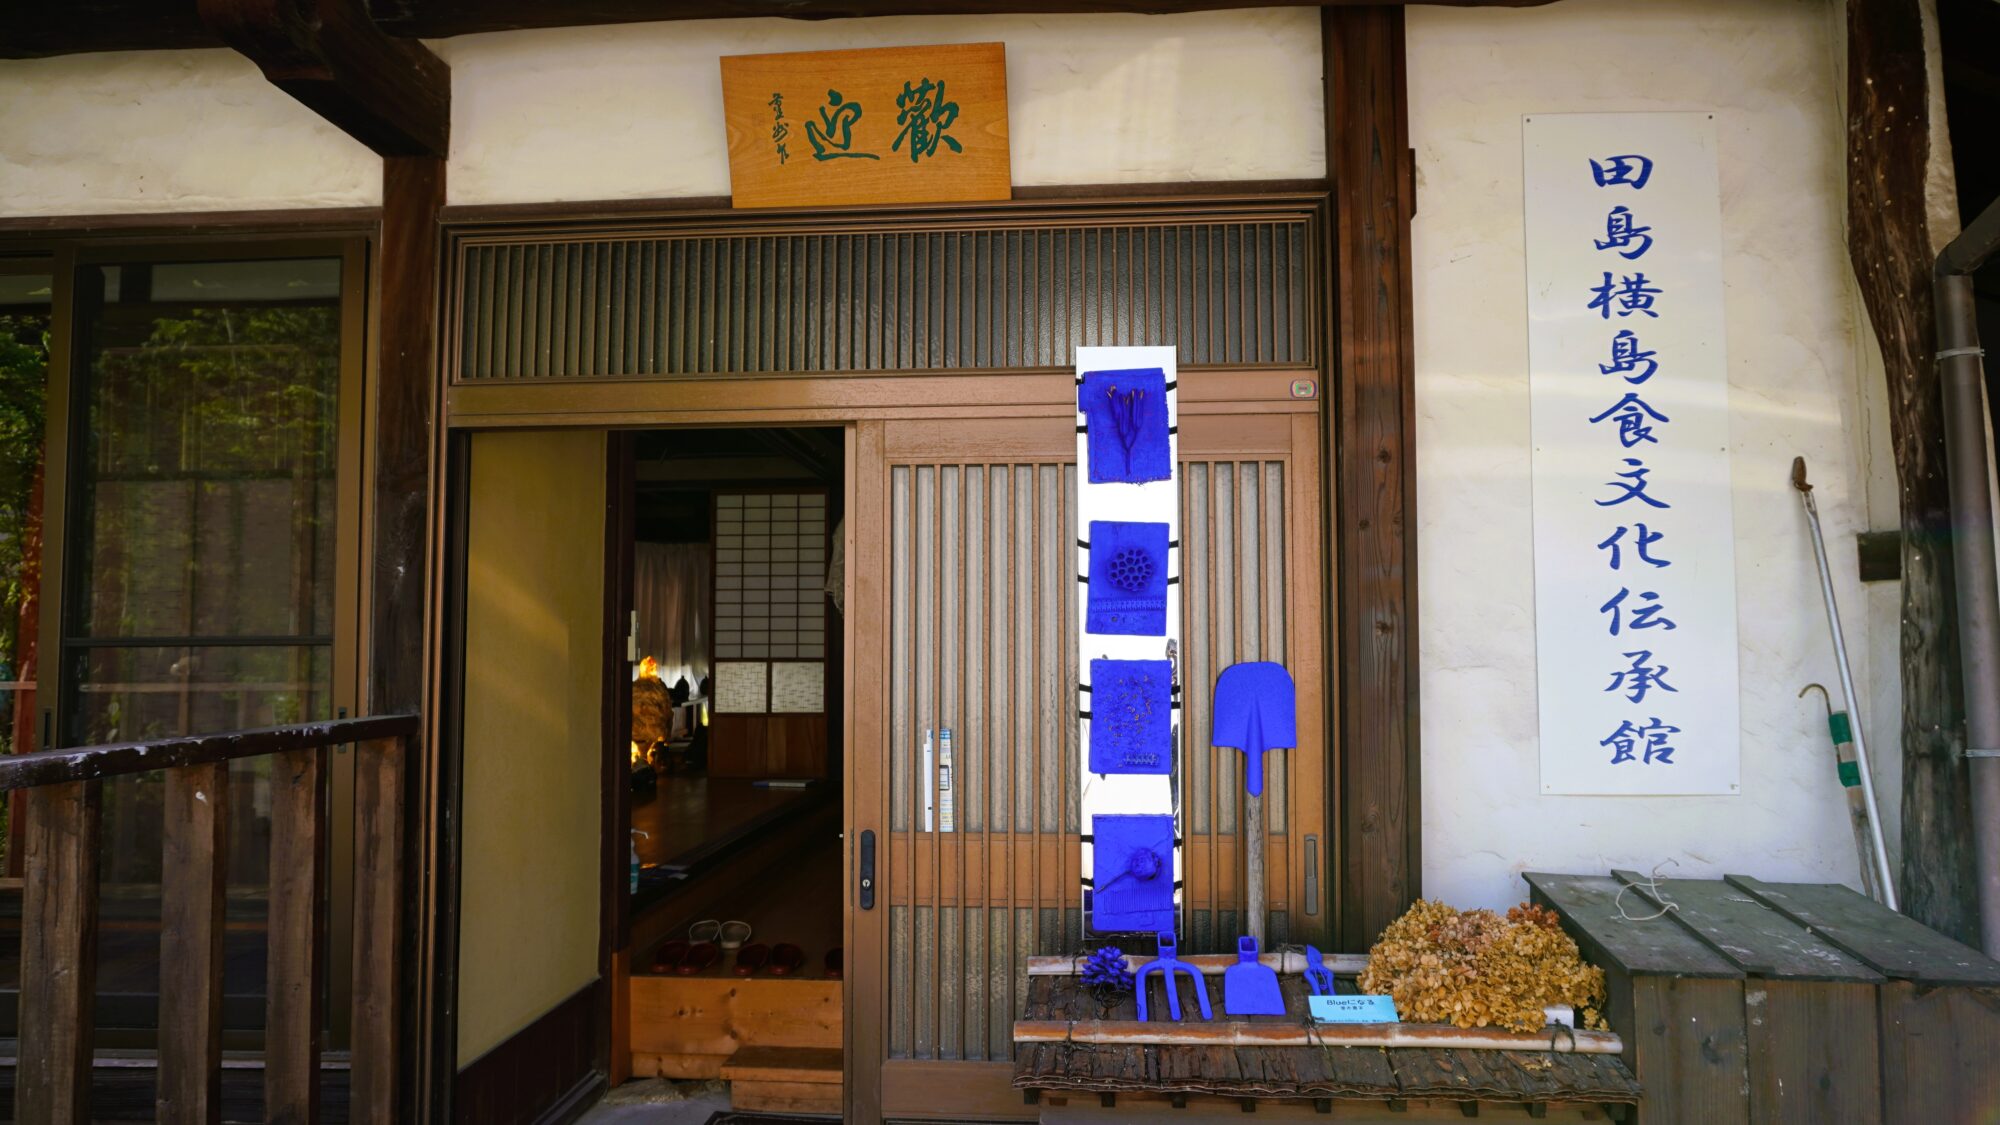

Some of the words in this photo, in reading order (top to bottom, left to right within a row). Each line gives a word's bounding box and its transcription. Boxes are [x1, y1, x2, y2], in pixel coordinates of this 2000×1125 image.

[1587, 154, 1682, 765] 田島横島食文化伝承館
